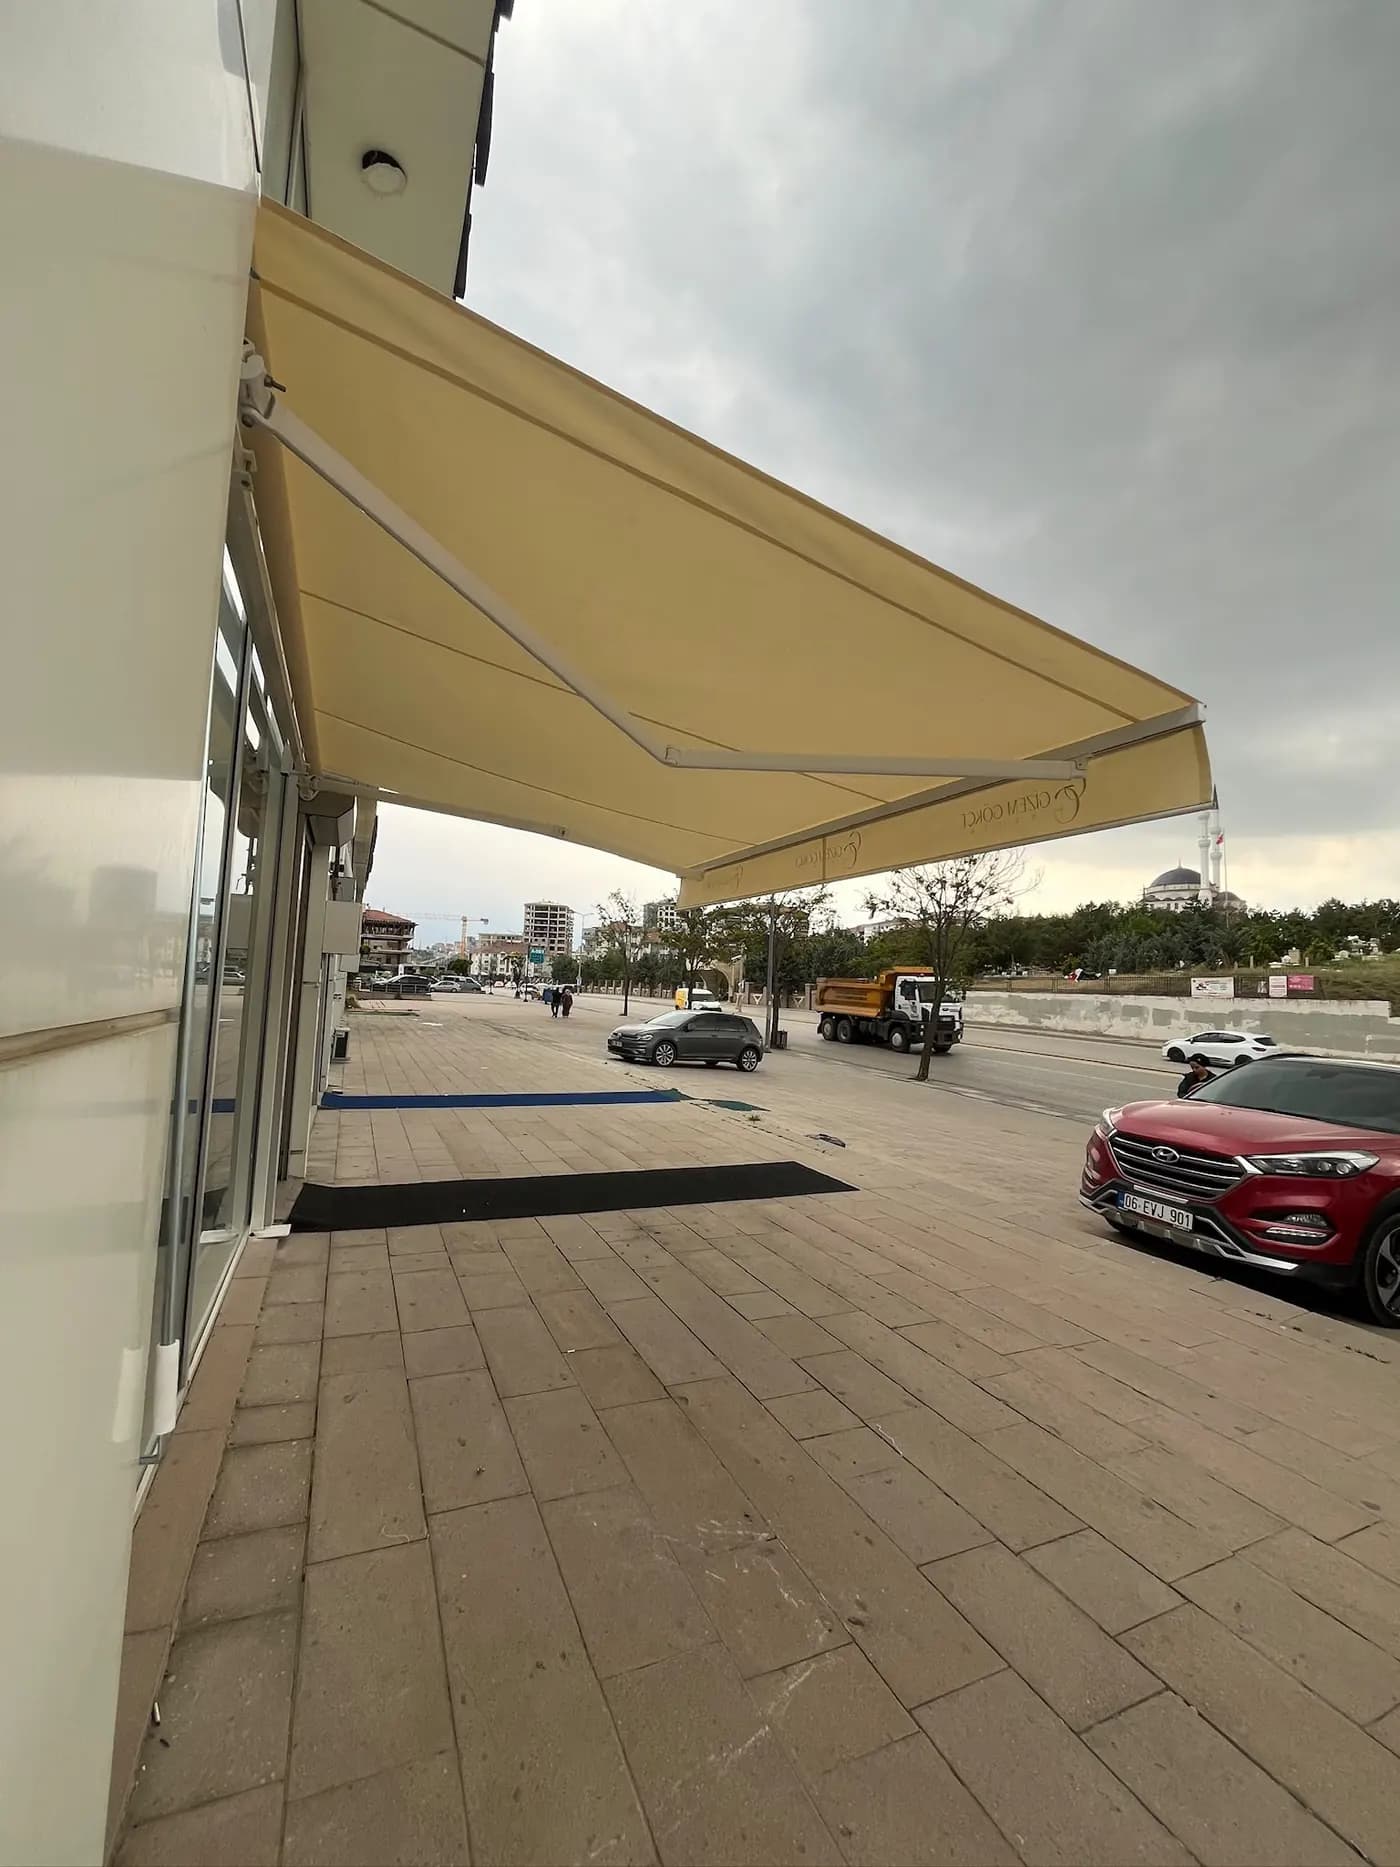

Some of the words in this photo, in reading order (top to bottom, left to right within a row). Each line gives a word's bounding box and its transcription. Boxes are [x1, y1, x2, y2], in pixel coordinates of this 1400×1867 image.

[1125, 1195, 1138, 1210] 06
[1143, 1200, 1164, 1218] EVJ
[1170, 1209, 1190, 1228] 901
